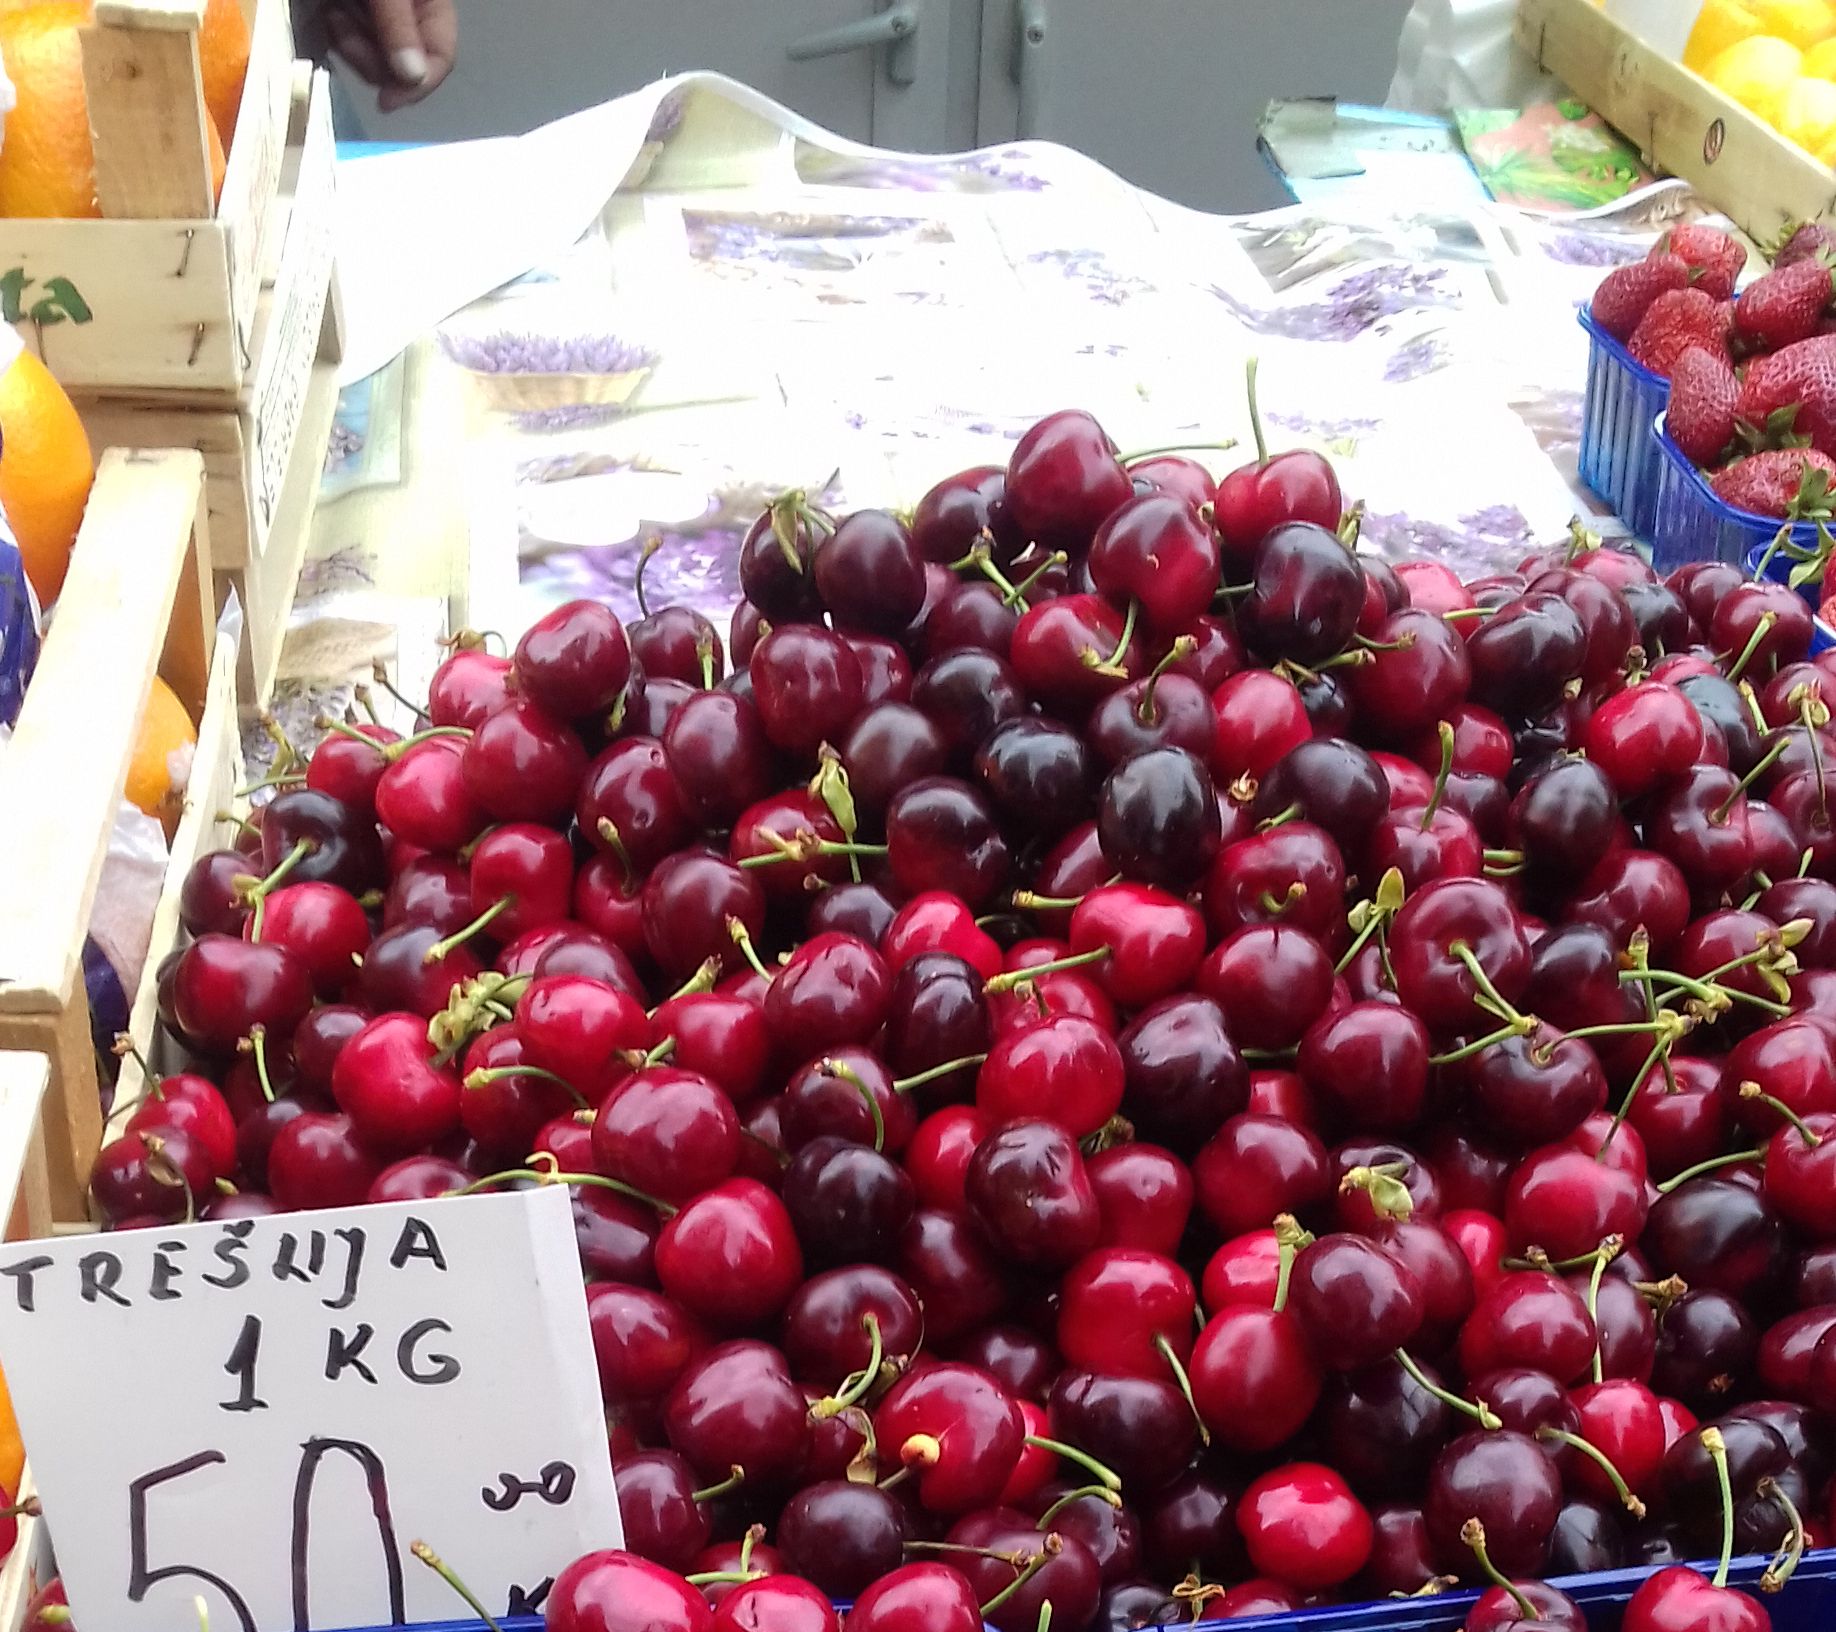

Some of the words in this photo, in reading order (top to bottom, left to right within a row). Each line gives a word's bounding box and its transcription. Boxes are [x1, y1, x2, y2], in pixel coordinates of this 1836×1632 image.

[0, 1216, 448, 1312] TREŠNJA
[219, 1314, 270, 1413] 1
[324, 1318, 462, 1385] KG
[507, 1576, 556, 1617] K
